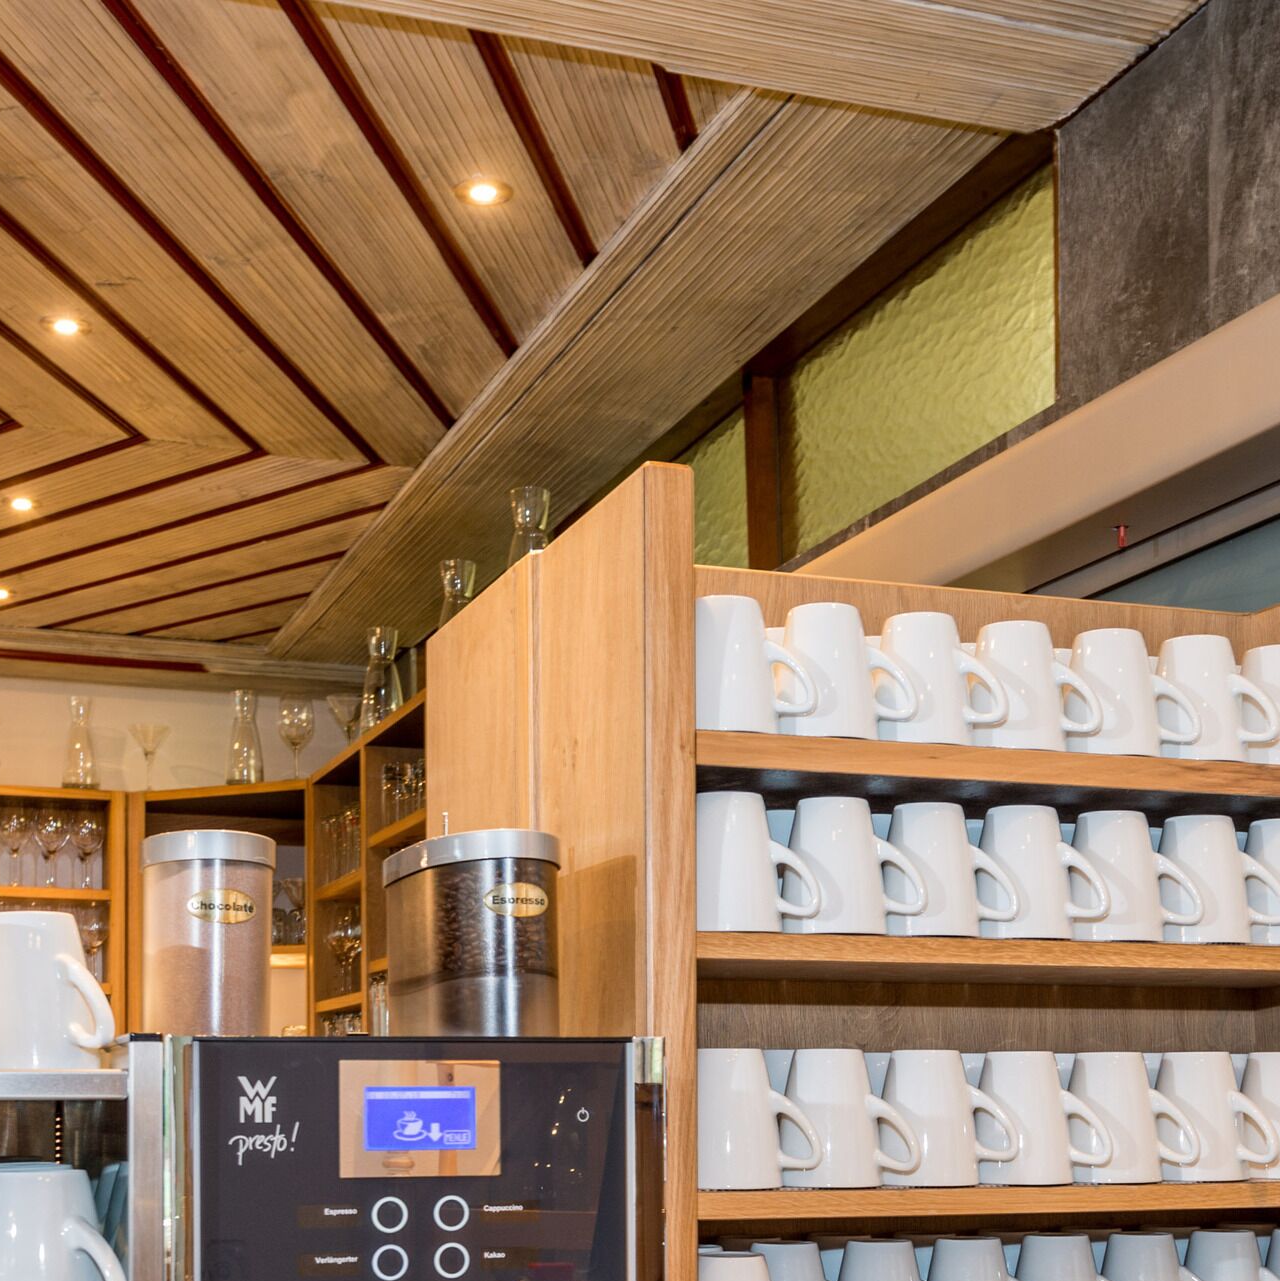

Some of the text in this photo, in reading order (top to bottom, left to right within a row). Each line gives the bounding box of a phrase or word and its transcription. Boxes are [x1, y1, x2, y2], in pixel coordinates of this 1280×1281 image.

[190, 900, 255, 914] Chocolate
[492, 895, 546, 907] Espresso
[237, 1076, 277, 1123] WMF
[228, 1121, 300, 1166] presto!
[323, 1207, 358, 1216] Espresso
[483, 1203, 523, 1213] Cappuccino
[483, 1251, 506, 1259] Kakao
